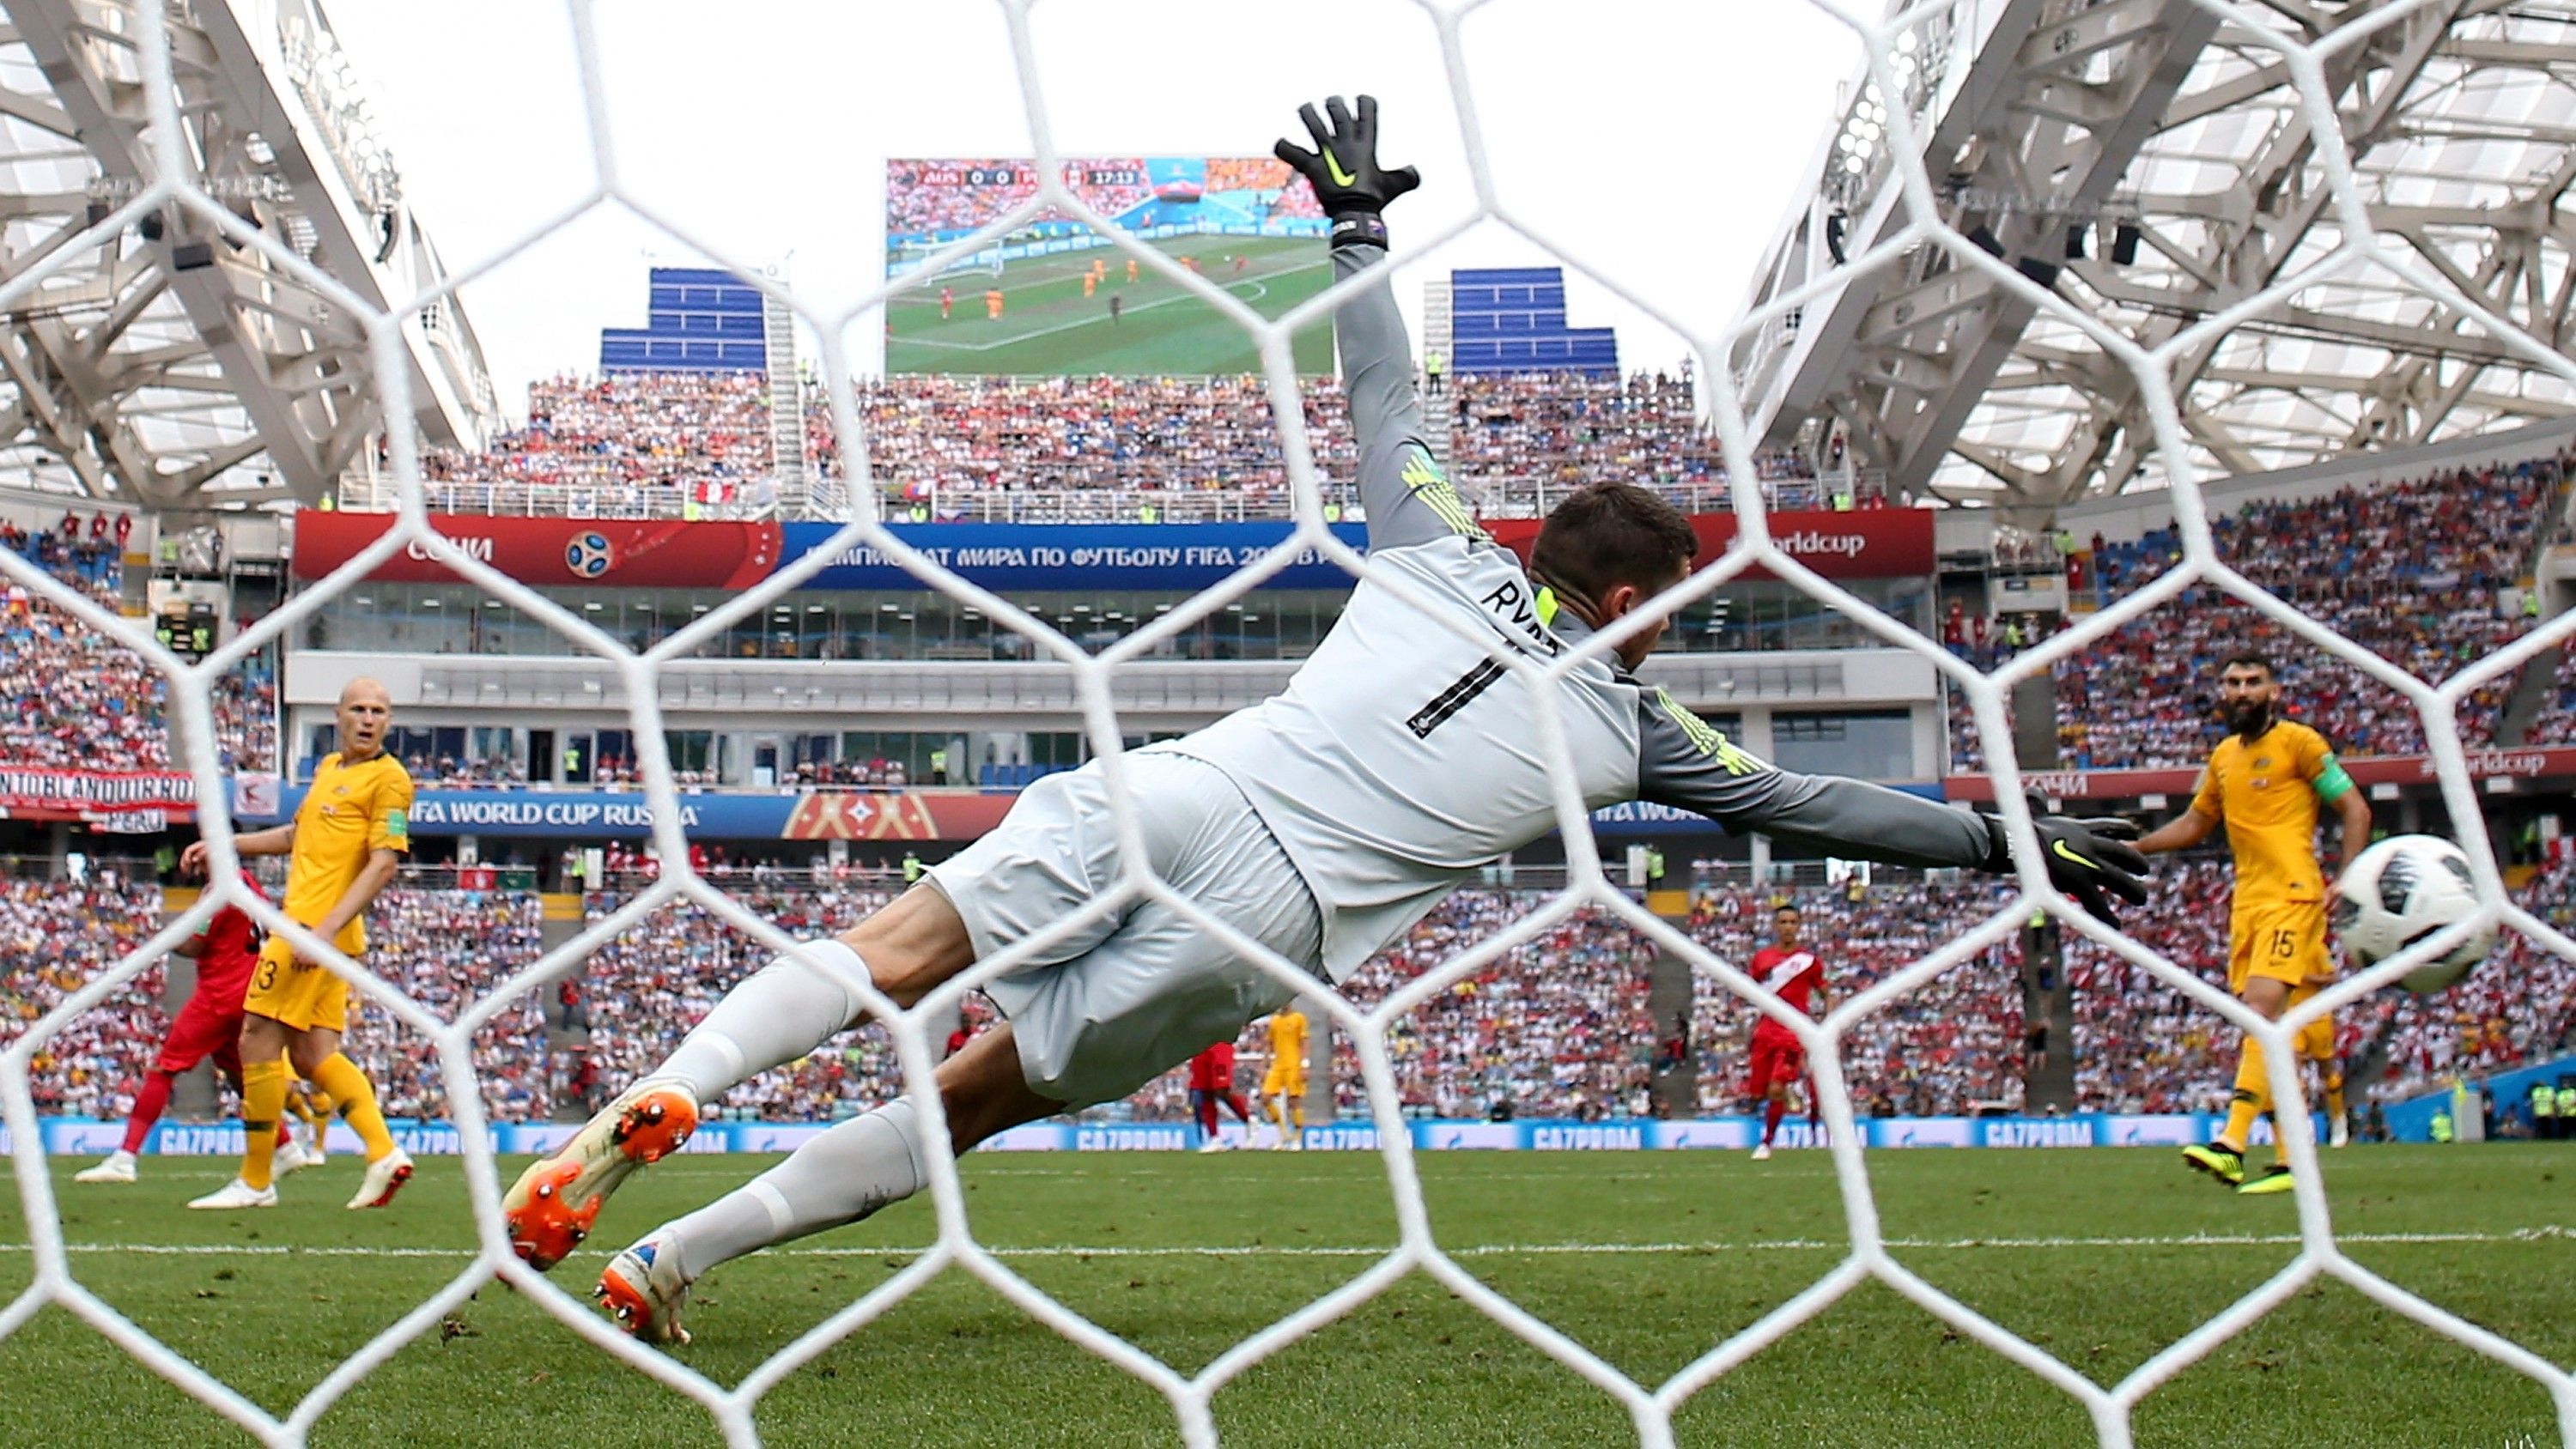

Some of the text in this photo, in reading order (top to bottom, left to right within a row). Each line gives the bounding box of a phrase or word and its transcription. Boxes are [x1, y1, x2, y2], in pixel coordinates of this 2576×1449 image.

[971, 171, 984, 185] 0
[996, 171, 1009, 185] 0
[1725, 530, 1866, 558] orldcup
[957, 548, 1026, 567] МИРА
[1031, 548, 1066, 567] ПО
[1071, 547, 1180, 567] ФУТБОЛУ
[1186, 547, 1235, 567] FIFA
[408, 800, 700, 826] IFA WORLD CUP RUSA
[2270, 930, 2297, 958] 15
[160, 1127, 247, 1155] GAZPRO
[1077, 1130, 1185, 1151] GAZPROM
[1304, 1128, 1413, 1150] GAZPR
[1534, 1127, 1642, 1150] GAZPROM
[1986, 1121, 2093, 1148] GAZPROM
